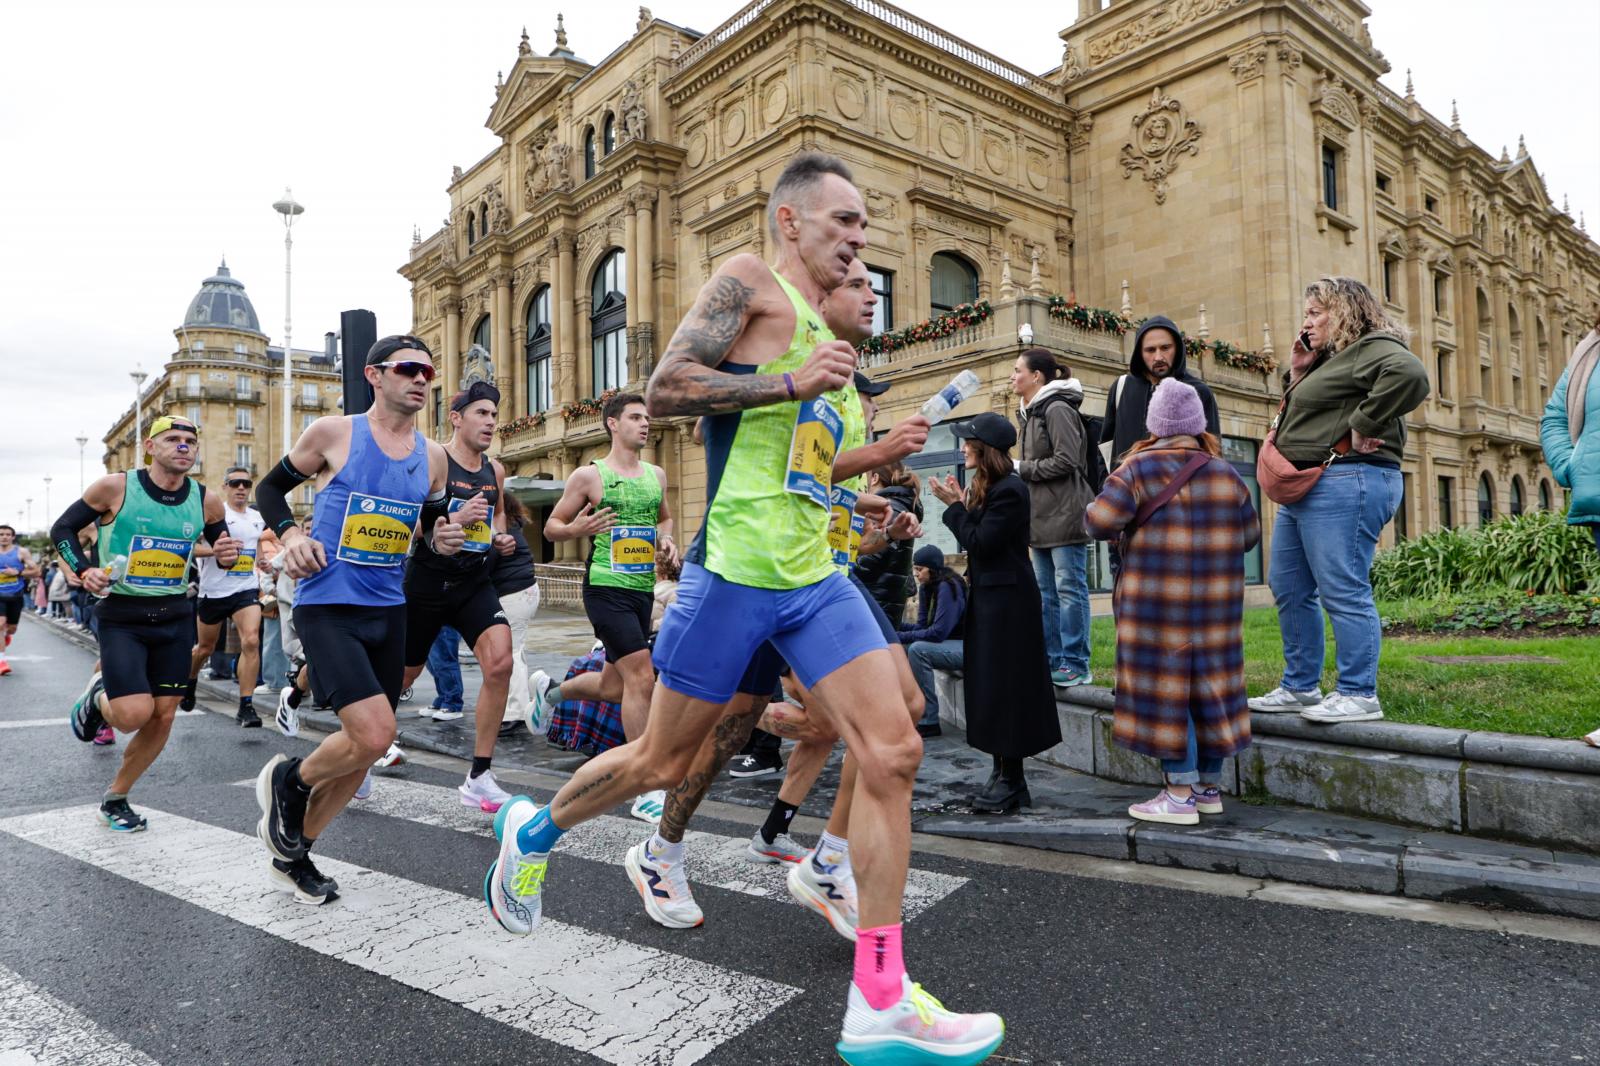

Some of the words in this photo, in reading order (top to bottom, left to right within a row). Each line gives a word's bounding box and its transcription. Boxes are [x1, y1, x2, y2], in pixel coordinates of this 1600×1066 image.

[378, 504, 413, 517] ZURICH
[357, 526, 410, 541] AGUSTIN
[156, 541, 185, 549] ZURICH
[373, 543, 389, 551] 592
[136, 560, 162, 568] JOSEP
